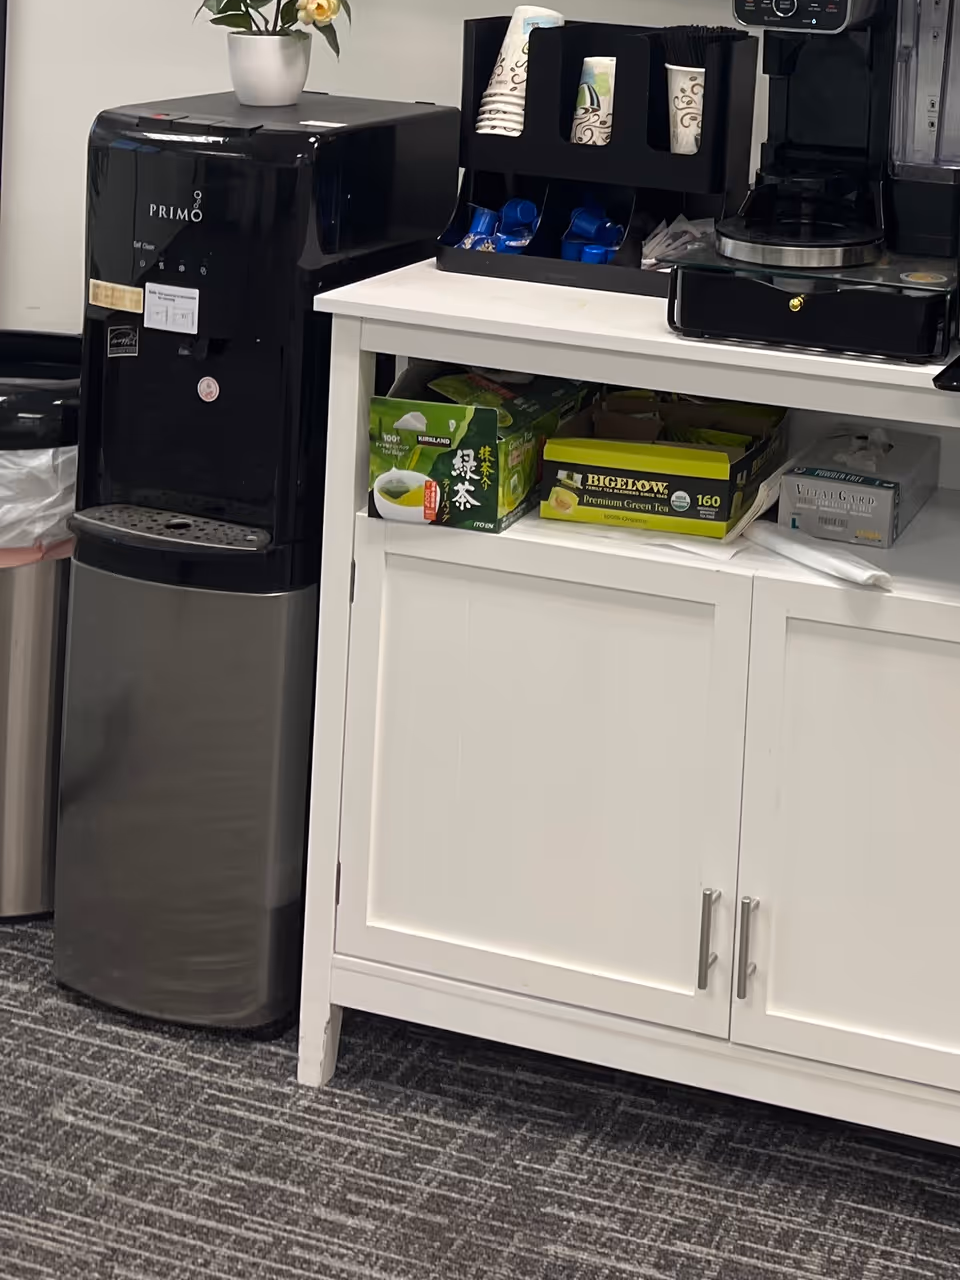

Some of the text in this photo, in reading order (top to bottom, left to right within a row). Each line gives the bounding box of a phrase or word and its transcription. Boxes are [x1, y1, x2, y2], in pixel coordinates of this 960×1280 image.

[149, 202, 203, 222] PRIMO
[417, 435, 451, 445] KIRKLAND
[450, 449, 482, 511] 緑茶
[586, 473, 669, 493] BIGELOW
[583, 494, 622, 508] Premium
[624, 499, 652, 511] Green
[653, 502, 669, 513] Tea
[696, 494, 721, 507] 160
